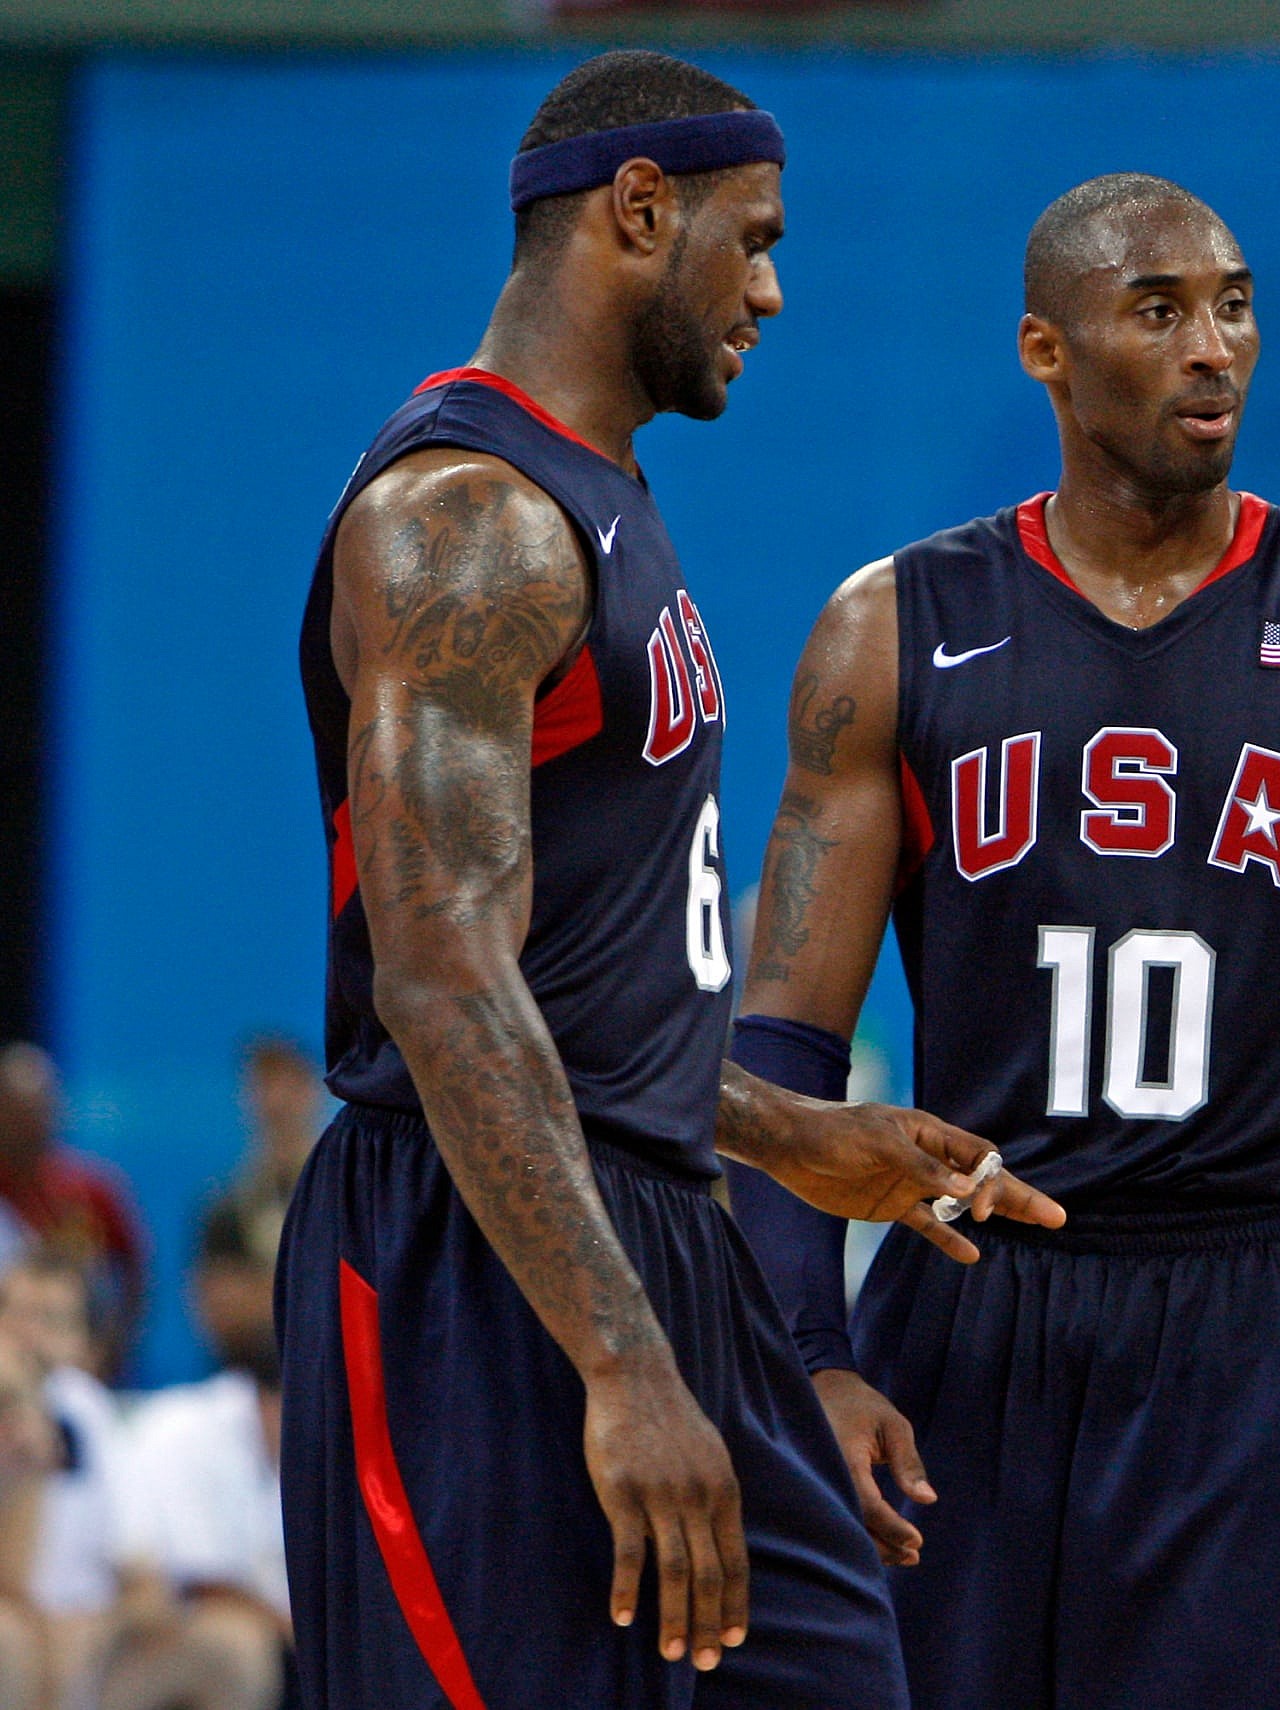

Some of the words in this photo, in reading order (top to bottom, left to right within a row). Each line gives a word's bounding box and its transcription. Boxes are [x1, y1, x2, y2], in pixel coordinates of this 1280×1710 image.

[642, 589, 726, 767] US
[686, 793, 732, 993] 6
[1036, 924, 1217, 1123] 10
